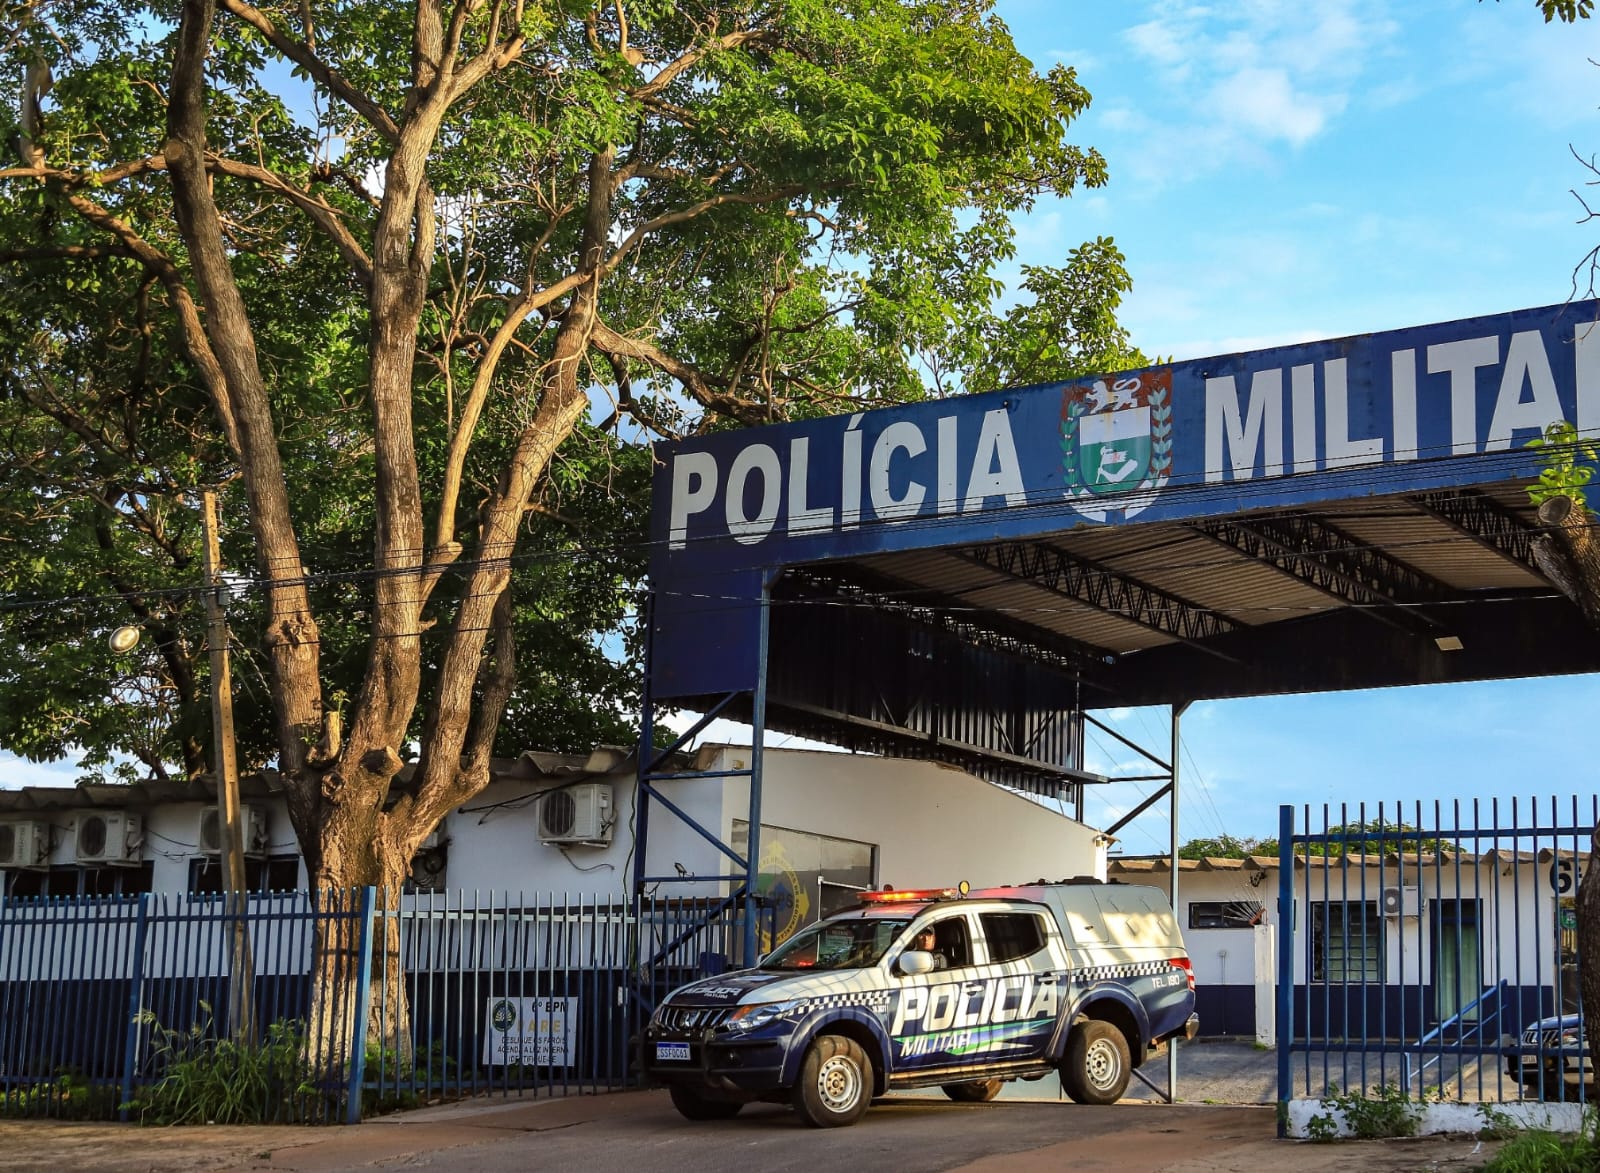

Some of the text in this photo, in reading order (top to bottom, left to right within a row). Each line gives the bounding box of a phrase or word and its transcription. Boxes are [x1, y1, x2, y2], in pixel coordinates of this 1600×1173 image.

[669, 408, 1028, 551] POLÍCIA
[1168, 975, 1180, 986] 190
[890, 975, 1058, 1036] POLICIA
[900, 1030, 972, 1056] MILITAR
